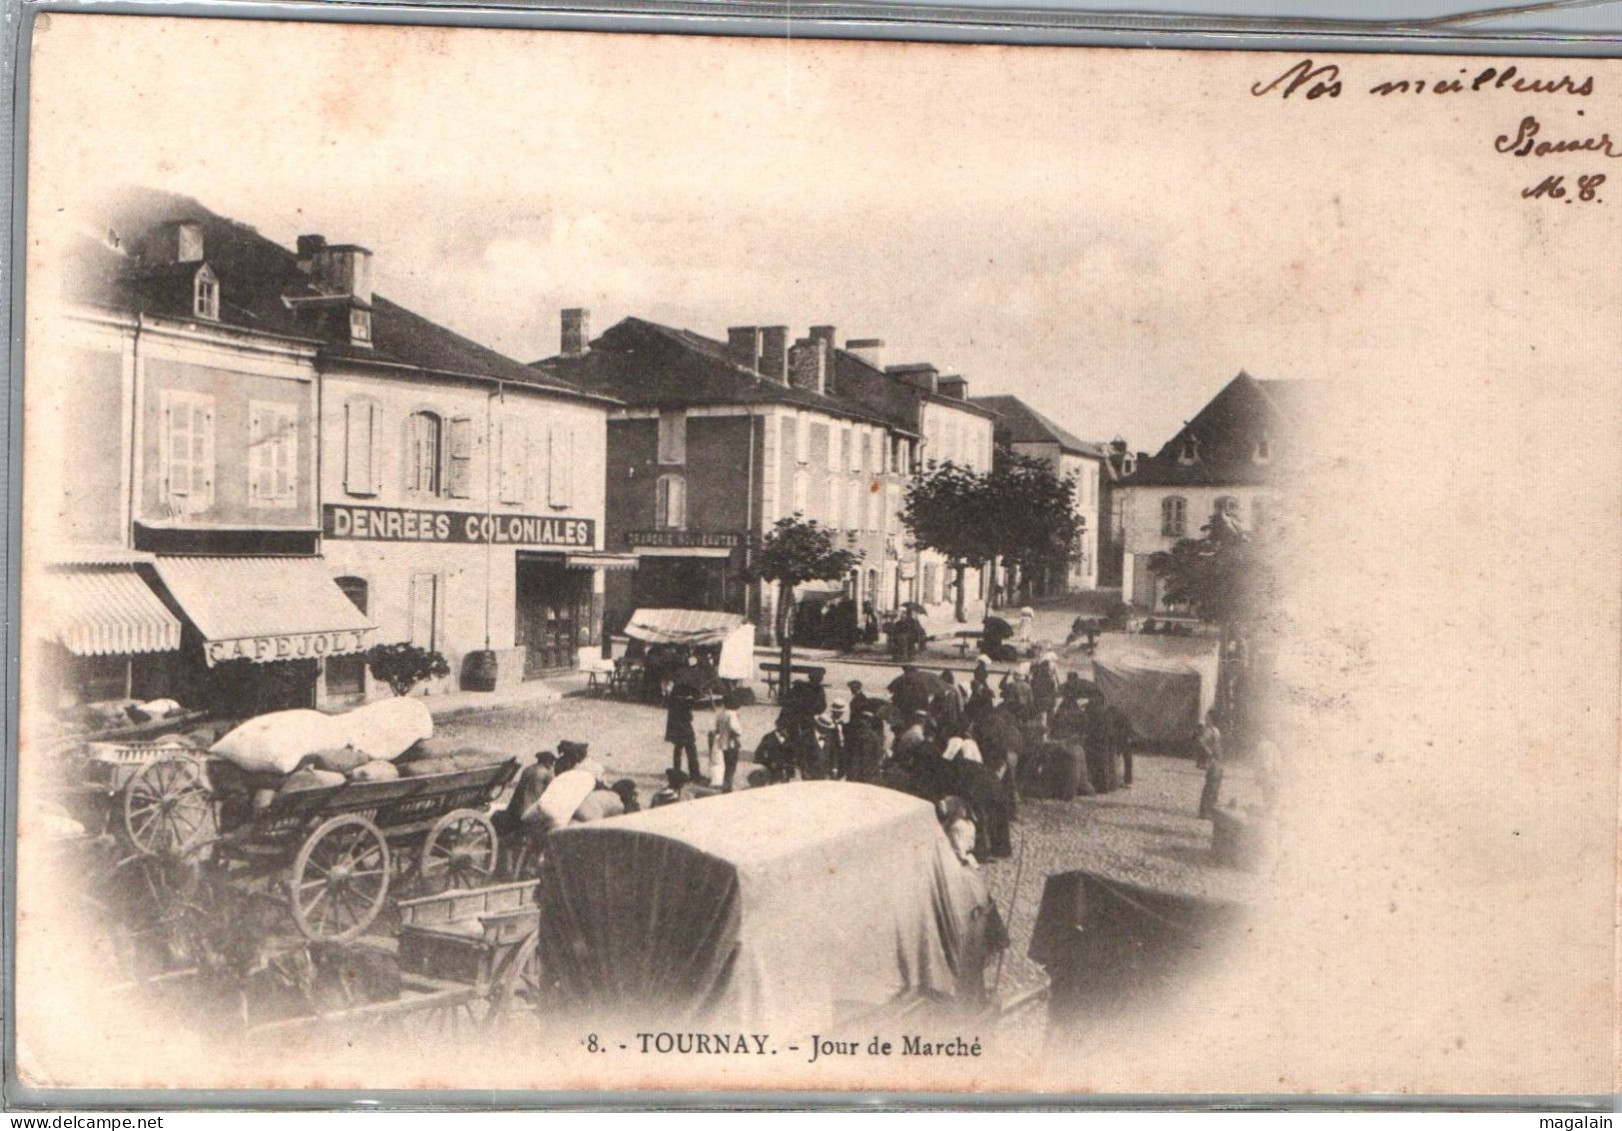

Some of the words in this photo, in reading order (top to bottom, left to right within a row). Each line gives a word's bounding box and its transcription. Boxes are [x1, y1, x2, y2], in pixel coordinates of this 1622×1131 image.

[1251, 59, 1342, 100] Nos
[1370, 66, 1594, 96] meilleurs
[465, 515, 588, 544] COLONIALES
